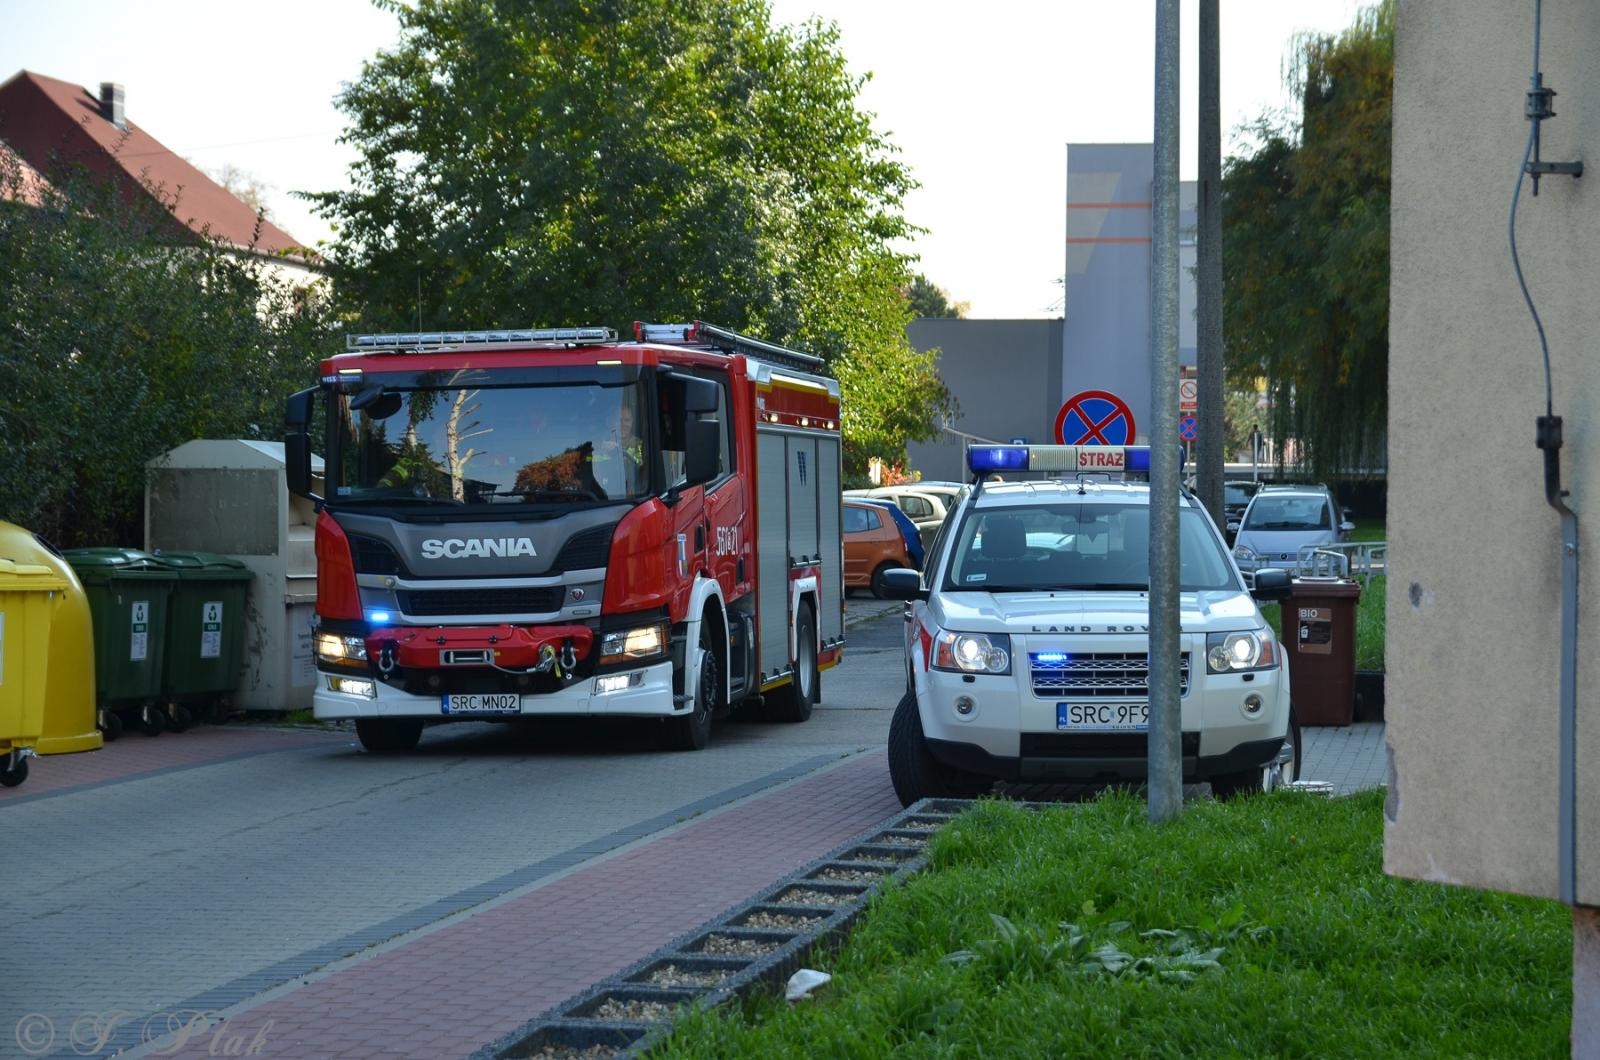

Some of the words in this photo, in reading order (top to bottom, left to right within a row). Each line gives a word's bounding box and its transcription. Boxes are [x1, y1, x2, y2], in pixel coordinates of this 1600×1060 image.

[421, 537, 537, 559] SCANIA
[1300, 609, 1318, 618] BIO
[451, 695, 478, 710] SRC
[482, 695, 516, 710] MN02
[1070, 705, 1111, 724] SRC
